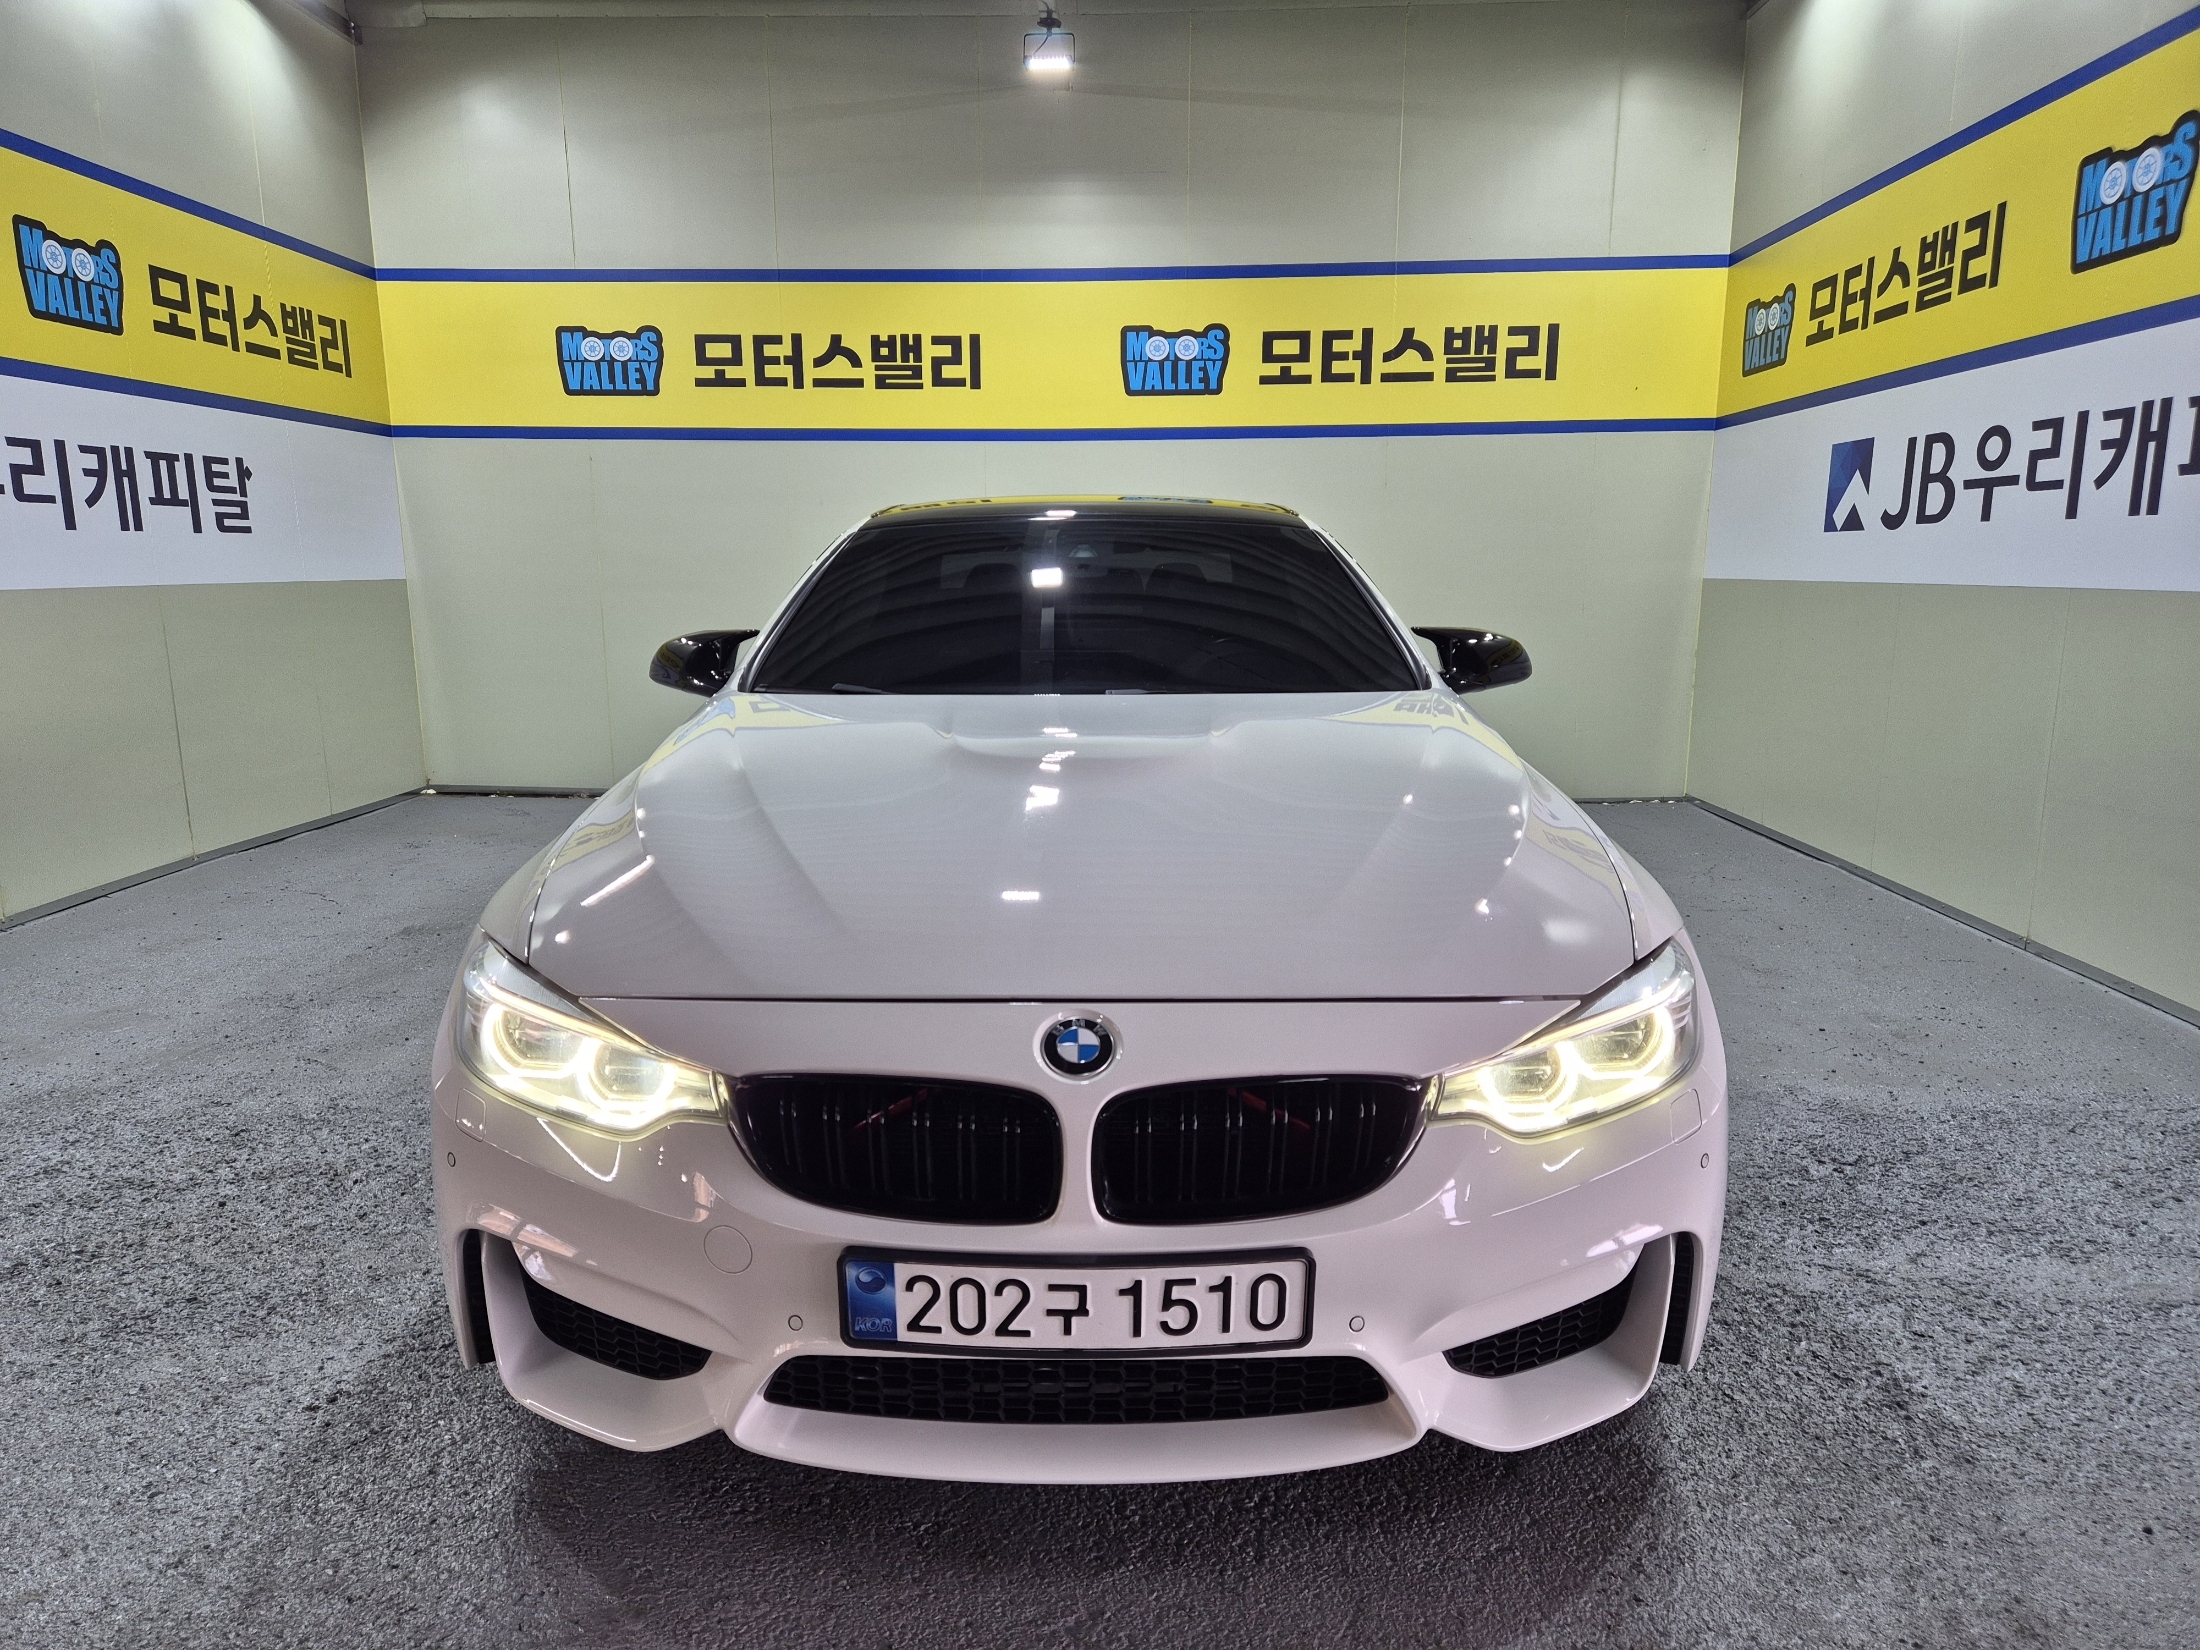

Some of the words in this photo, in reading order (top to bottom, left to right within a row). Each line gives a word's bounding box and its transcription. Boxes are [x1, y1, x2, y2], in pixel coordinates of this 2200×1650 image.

[2076, 177, 2189, 264] VALLEY
[24, 267, 119, 329] VALLEY
[1805, 201, 2007, 347] 모터스밸리
[148, 264, 352, 378] 모터스밸리
[1745, 326, 1790, 371] VALLEY
[563, 361, 657, 390] VALLEY
[694, 333, 981, 389] 모터스밸리
[1126, 360, 1219, 391] VALLEY
[1259, 323, 1560, 385] 모터스밸리
[0, 436, 253, 534] 리캐피탈
[1050, 1018, 1108, 1036] BMW
[854, 1317, 892, 1333] KOR
[905, 1275, 1089, 1337] 202구
[1118, 1273, 1287, 1338] 1510
